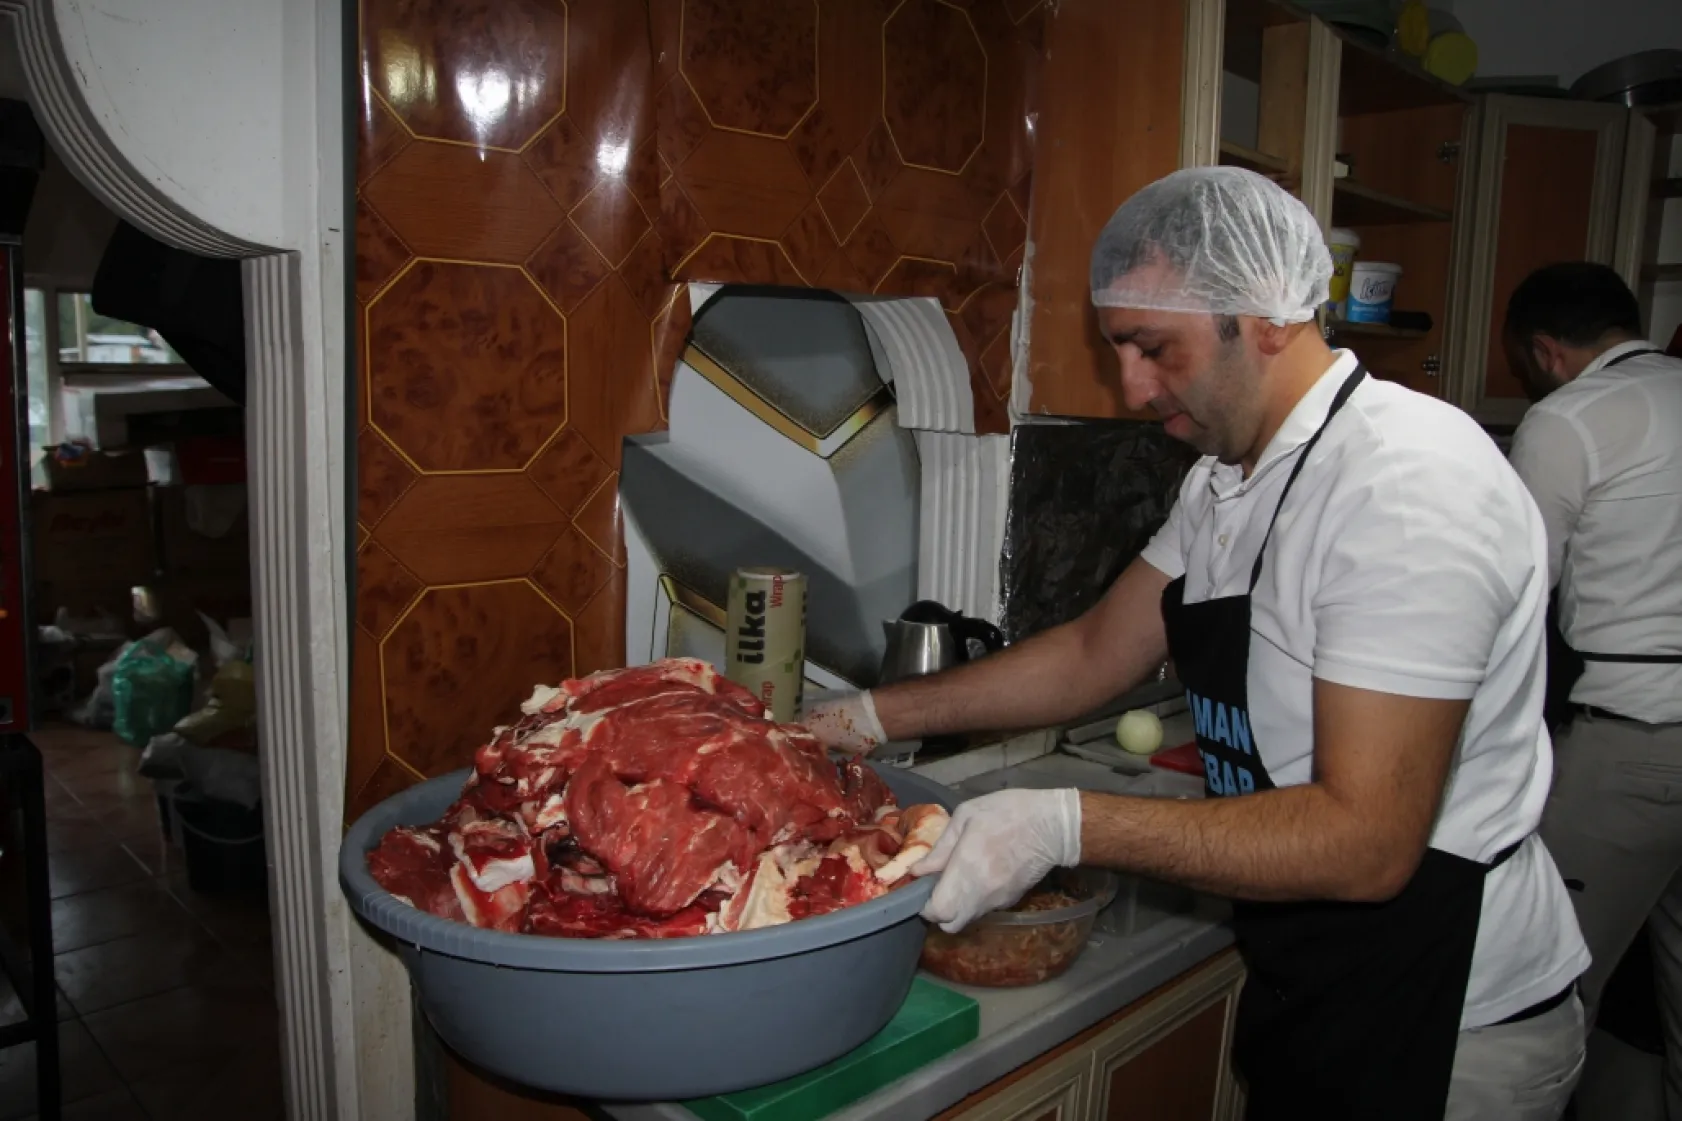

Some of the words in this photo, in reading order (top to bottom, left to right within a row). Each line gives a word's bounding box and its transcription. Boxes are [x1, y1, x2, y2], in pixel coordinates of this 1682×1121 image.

[769, 574, 784, 608] Wrap
[737, 590, 767, 664] ilka
[1199, 749, 1256, 796] BAP
